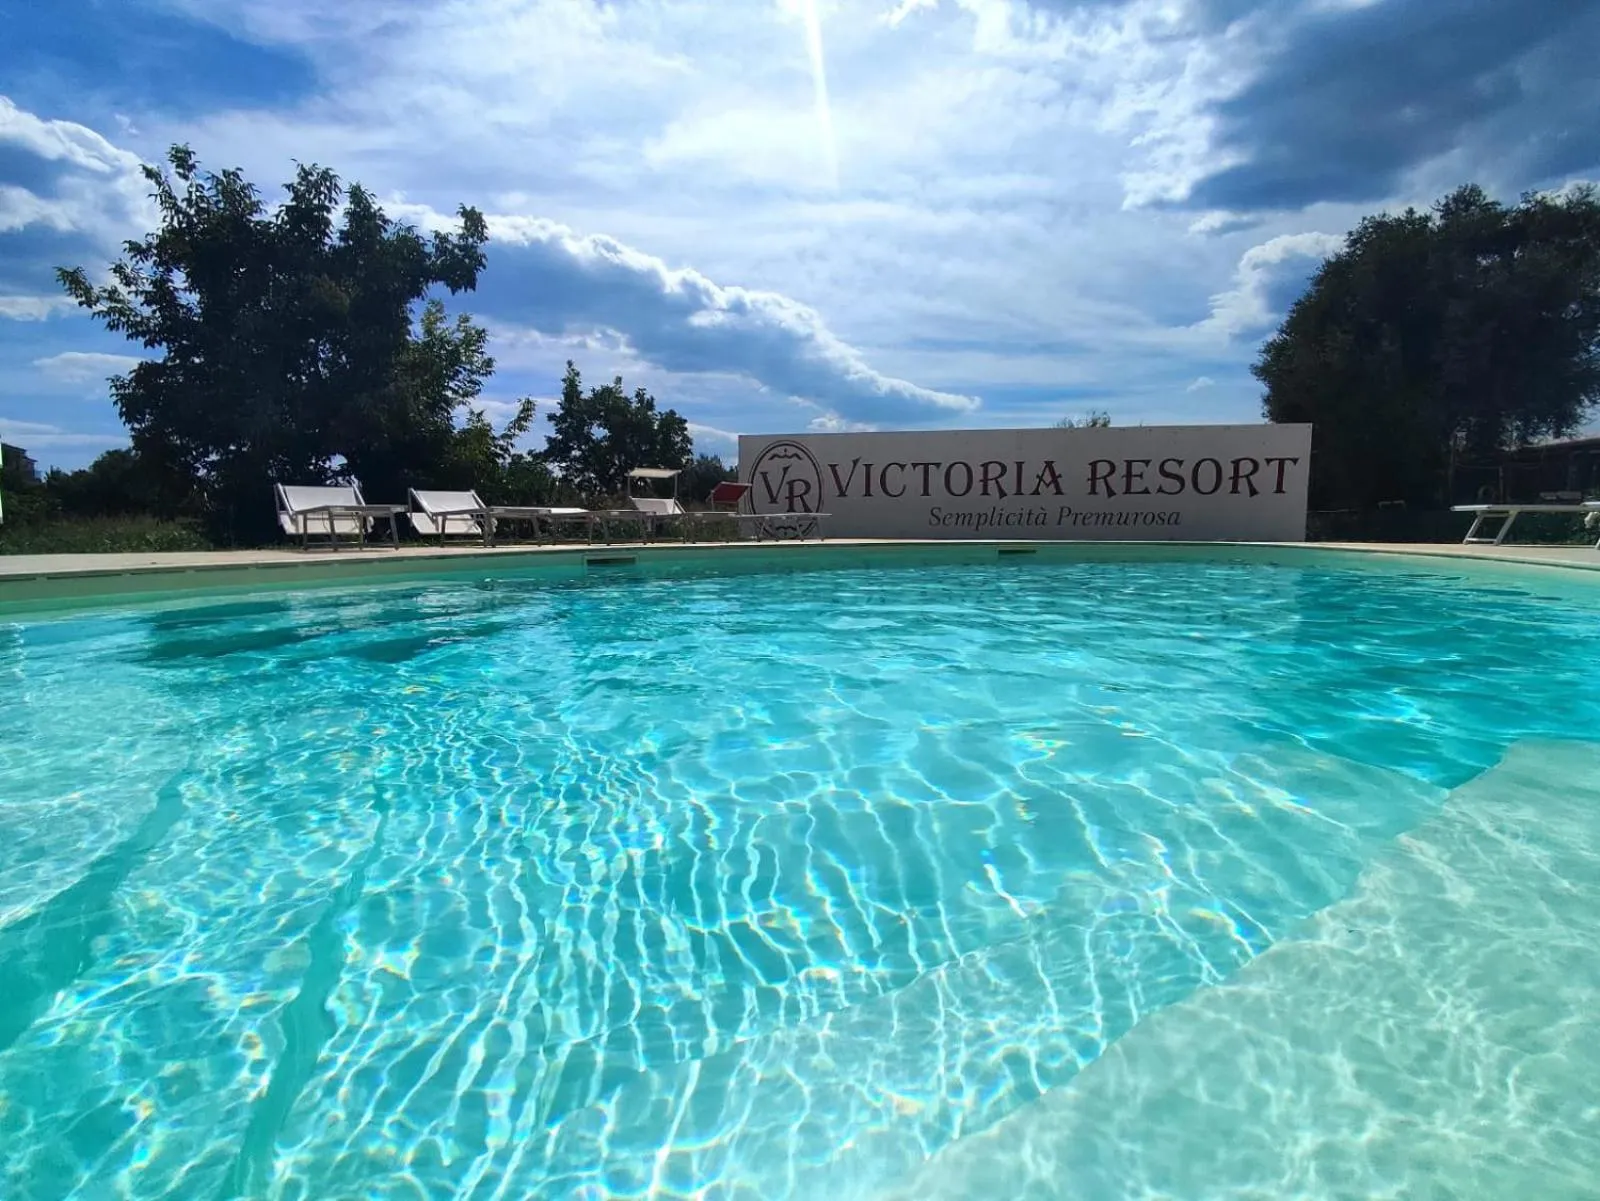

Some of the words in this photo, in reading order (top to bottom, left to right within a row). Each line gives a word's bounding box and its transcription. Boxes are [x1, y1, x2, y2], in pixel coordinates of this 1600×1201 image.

[760, 463, 813, 513] VR
[827, 457, 1065, 499] VICTORIA
[1086, 456, 1299, 499] RESORT
[928, 505, 1048, 532] Semplicità
[1056, 506, 1182, 529] Premurosa
